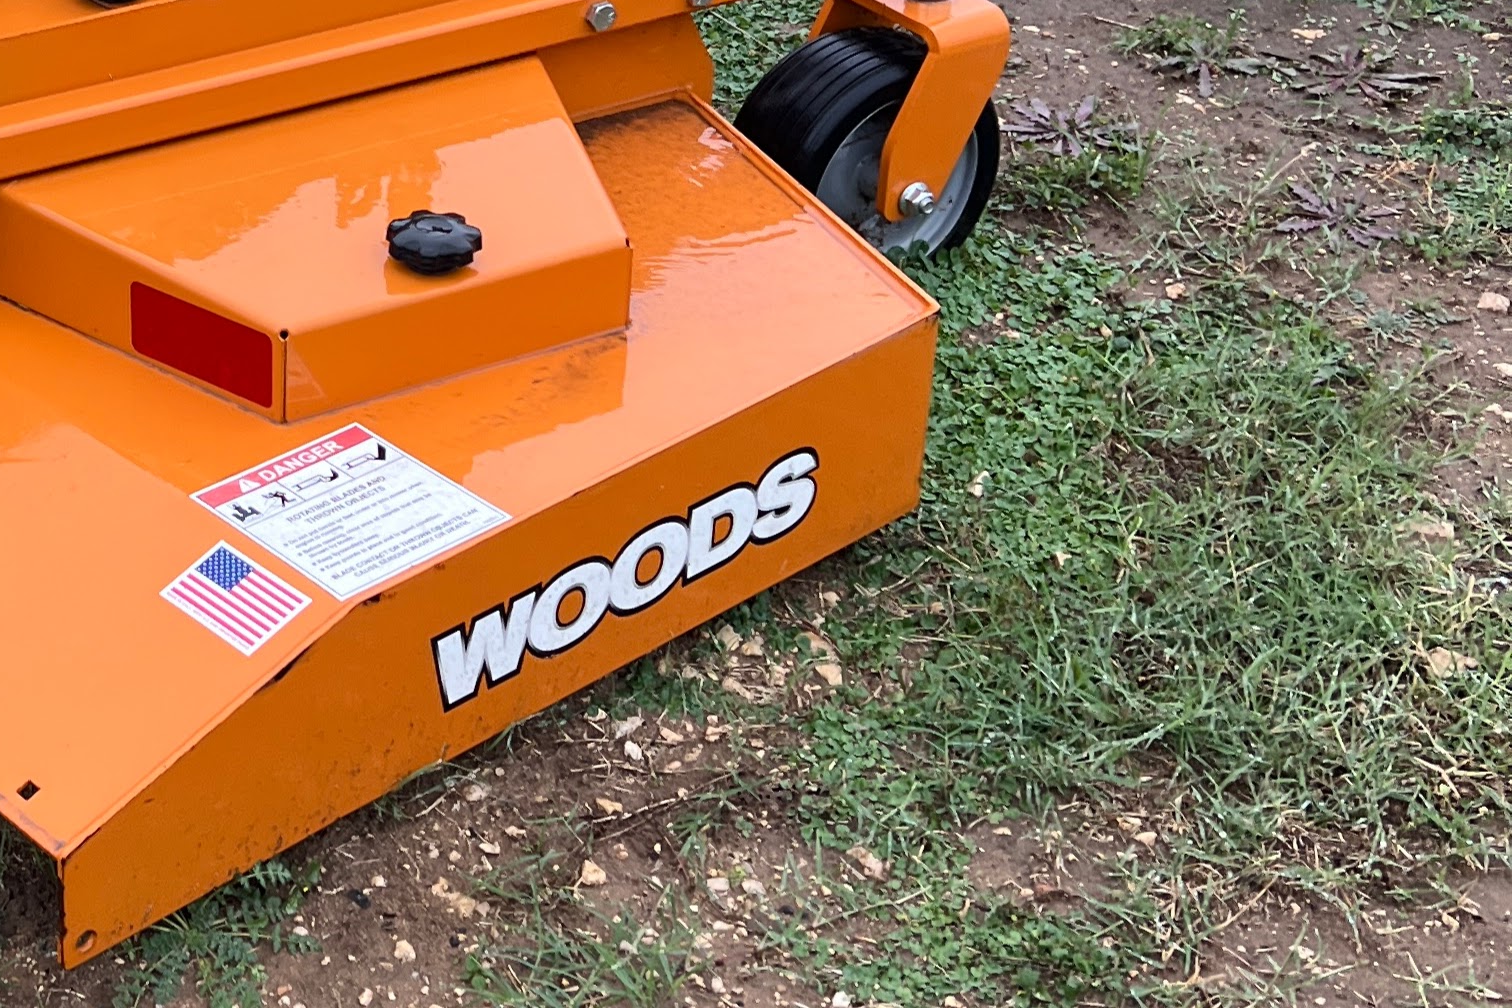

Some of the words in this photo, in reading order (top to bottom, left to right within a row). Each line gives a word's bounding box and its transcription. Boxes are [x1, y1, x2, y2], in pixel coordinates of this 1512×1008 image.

[255, 439, 344, 482] DANGER
[284, 499, 333, 523] ROTATING
[328, 483, 368, 503] BLADES
[362, 474, 387, 487] AND
[303, 503, 346, 524] THROWN
[342, 484, 387, 506] OBJECTS
[431, 447, 819, 713] WOODS
